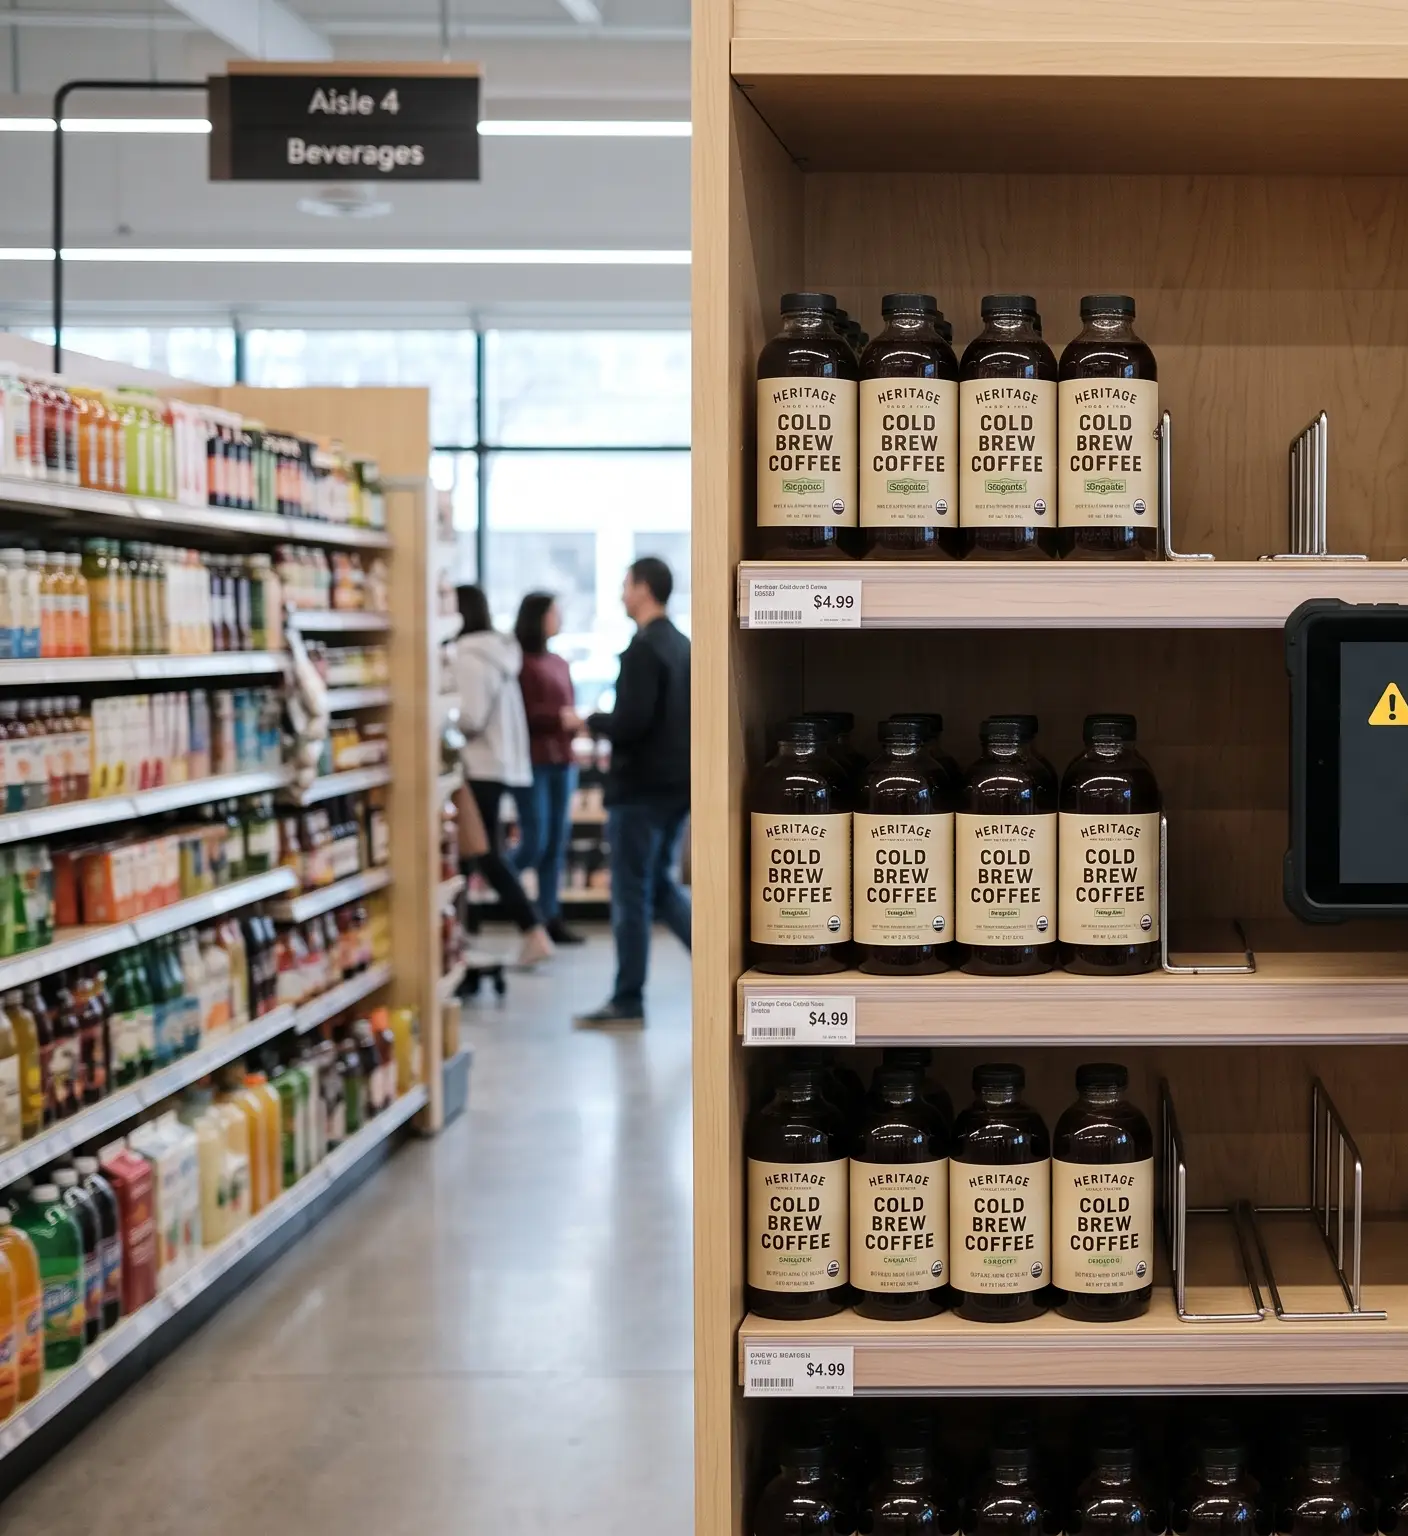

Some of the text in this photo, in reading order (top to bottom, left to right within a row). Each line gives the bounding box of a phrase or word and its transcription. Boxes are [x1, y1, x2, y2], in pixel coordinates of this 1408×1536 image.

[307, 87, 400, 115] Aisle 4
[287, 137, 425, 172] Beverages
[773, 387, 837, 404] HERITAGE
[878, 388, 941, 404] HERITAGE
[975, 388, 1039, 404] HERITAGE
[1074, 388, 1137, 404] HERITAGE
[778, 414, 831, 430] COLD
[882, 414, 936, 431] COLD
[980, 414, 1033, 431] COLD
[1079, 414, 1132, 430] COLD
[776, 435, 834, 450] BREW
[881, 435, 938, 451] BREW
[979, 435, 1036, 451] BREW
[1077, 435, 1133, 450] BREW
[769, 455, 841, 471] COFFEE
[873, 456, 945, 472] COFFEE
[971, 456, 1043, 472] COFFEE
[1070, 455, 1141, 472] COFFEE
[813, 594, 854, 609] $4.99
[765, 823, 827, 838] HERITAGE
[871, 824, 932, 839] HERITAGE
[974, 824, 1036, 839] HERITAGE
[1080, 823, 1141, 839] HERITAGE
[771, 849, 821, 865] COLD
[875, 850, 926, 865] COLD
[980, 850, 1030, 865] COLD
[1085, 849, 1135, 865] COLD
[768, 868, 824, 884] BREW
[874, 868, 929, 884] BREW
[978, 868, 1034, 884] BREW
[1083, 867, 1138, 883] BREW
[762, 887, 832, 902] COFFEE
[867, 887, 937, 903] COFFEE
[971, 887, 1041, 903] COFFEE
[1076, 886, 1145, 902] COFFEE
[809, 1011, 848, 1026] $4.99
[765, 1173, 826, 1186] HERITAGE
[969, 1174, 1030, 1188] HERITAGE
[1074, 1174, 1135, 1187] HERITAGE
[770, 1197, 820, 1212] COLD
[874, 1197, 924, 1213] COLD
[974, 1198, 1024, 1213] COLD
[1079, 1197, 1130, 1213] COLD
[768, 1215, 822, 1231] BREW
[872, 1215, 926, 1231] BREW
[972, 1216, 1027, 1233] BREW
[1078, 1216, 1131, 1232] BREW
[761, 1233, 831, 1250] COFFEE
[865, 1233, 934, 1250] COFFEE
[965, 1234, 1034, 1251] COFFEE
[1070, 1233, 1139, 1251] COFFEE
[807, 1363, 845, 1377] $4.99
